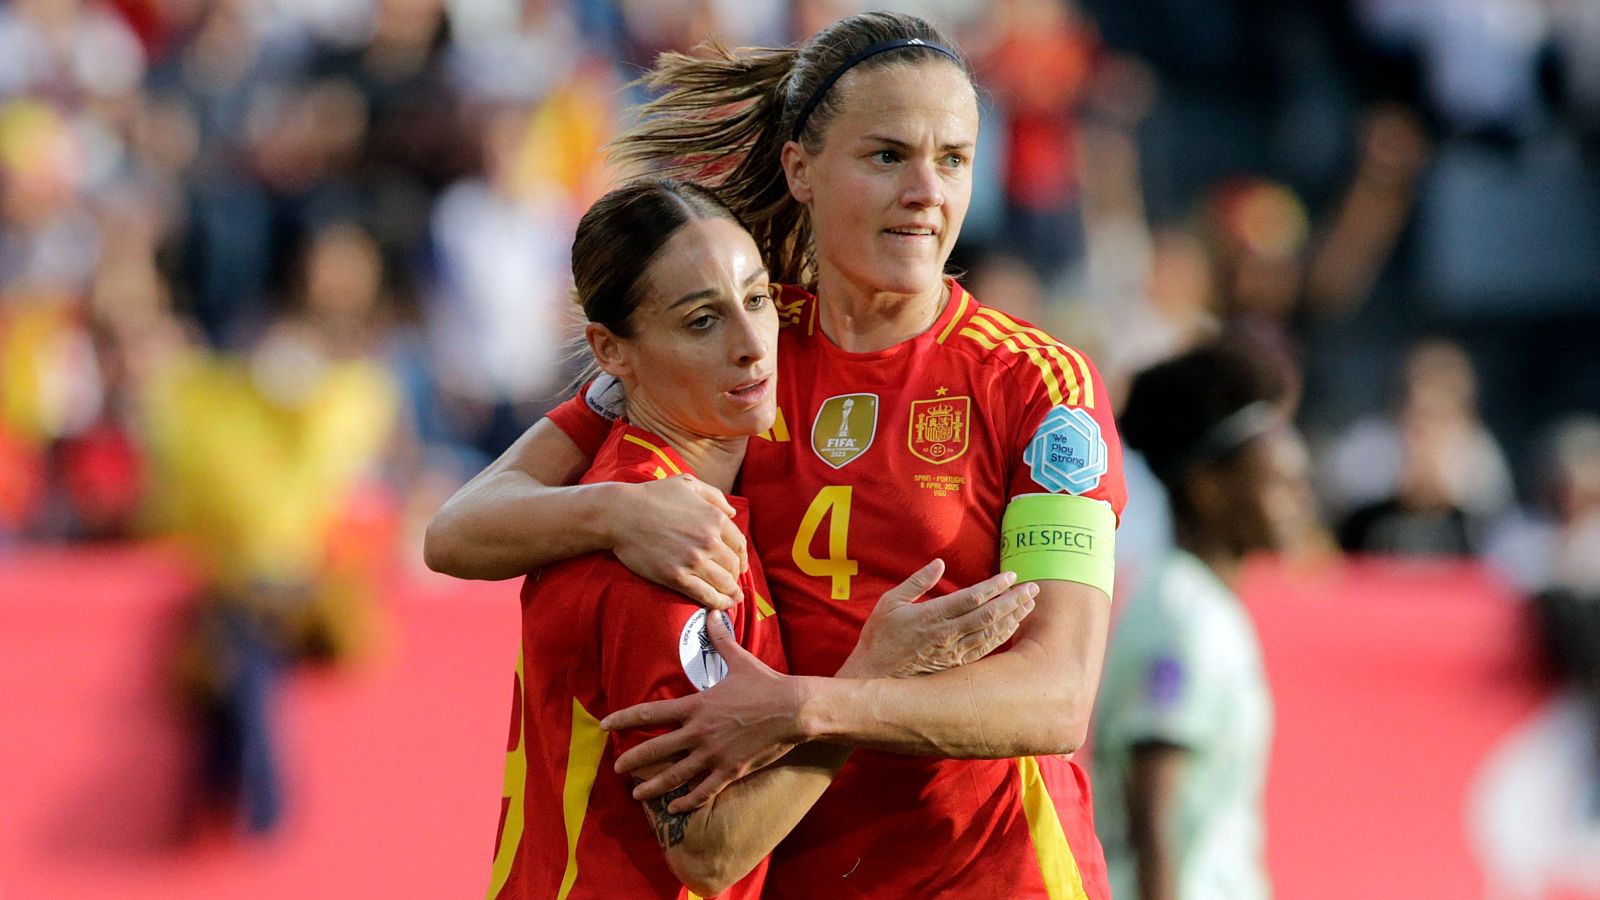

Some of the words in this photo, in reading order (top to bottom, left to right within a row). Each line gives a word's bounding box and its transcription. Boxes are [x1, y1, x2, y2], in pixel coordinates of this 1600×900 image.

[827, 438, 855, 448] FIFA
[1052, 433, 1067, 443] We
[1051, 443, 1073, 456] Play
[1051, 453, 1085, 467] Strong
[936, 475, 965, 484] PORTUGAL
[926, 482, 942, 490] APRIL
[944, 483, 960, 491] 2025
[933, 489, 947, 497] VIGO
[792, 486, 858, 600] 4
[1016, 530, 1093, 550] RESPECT
